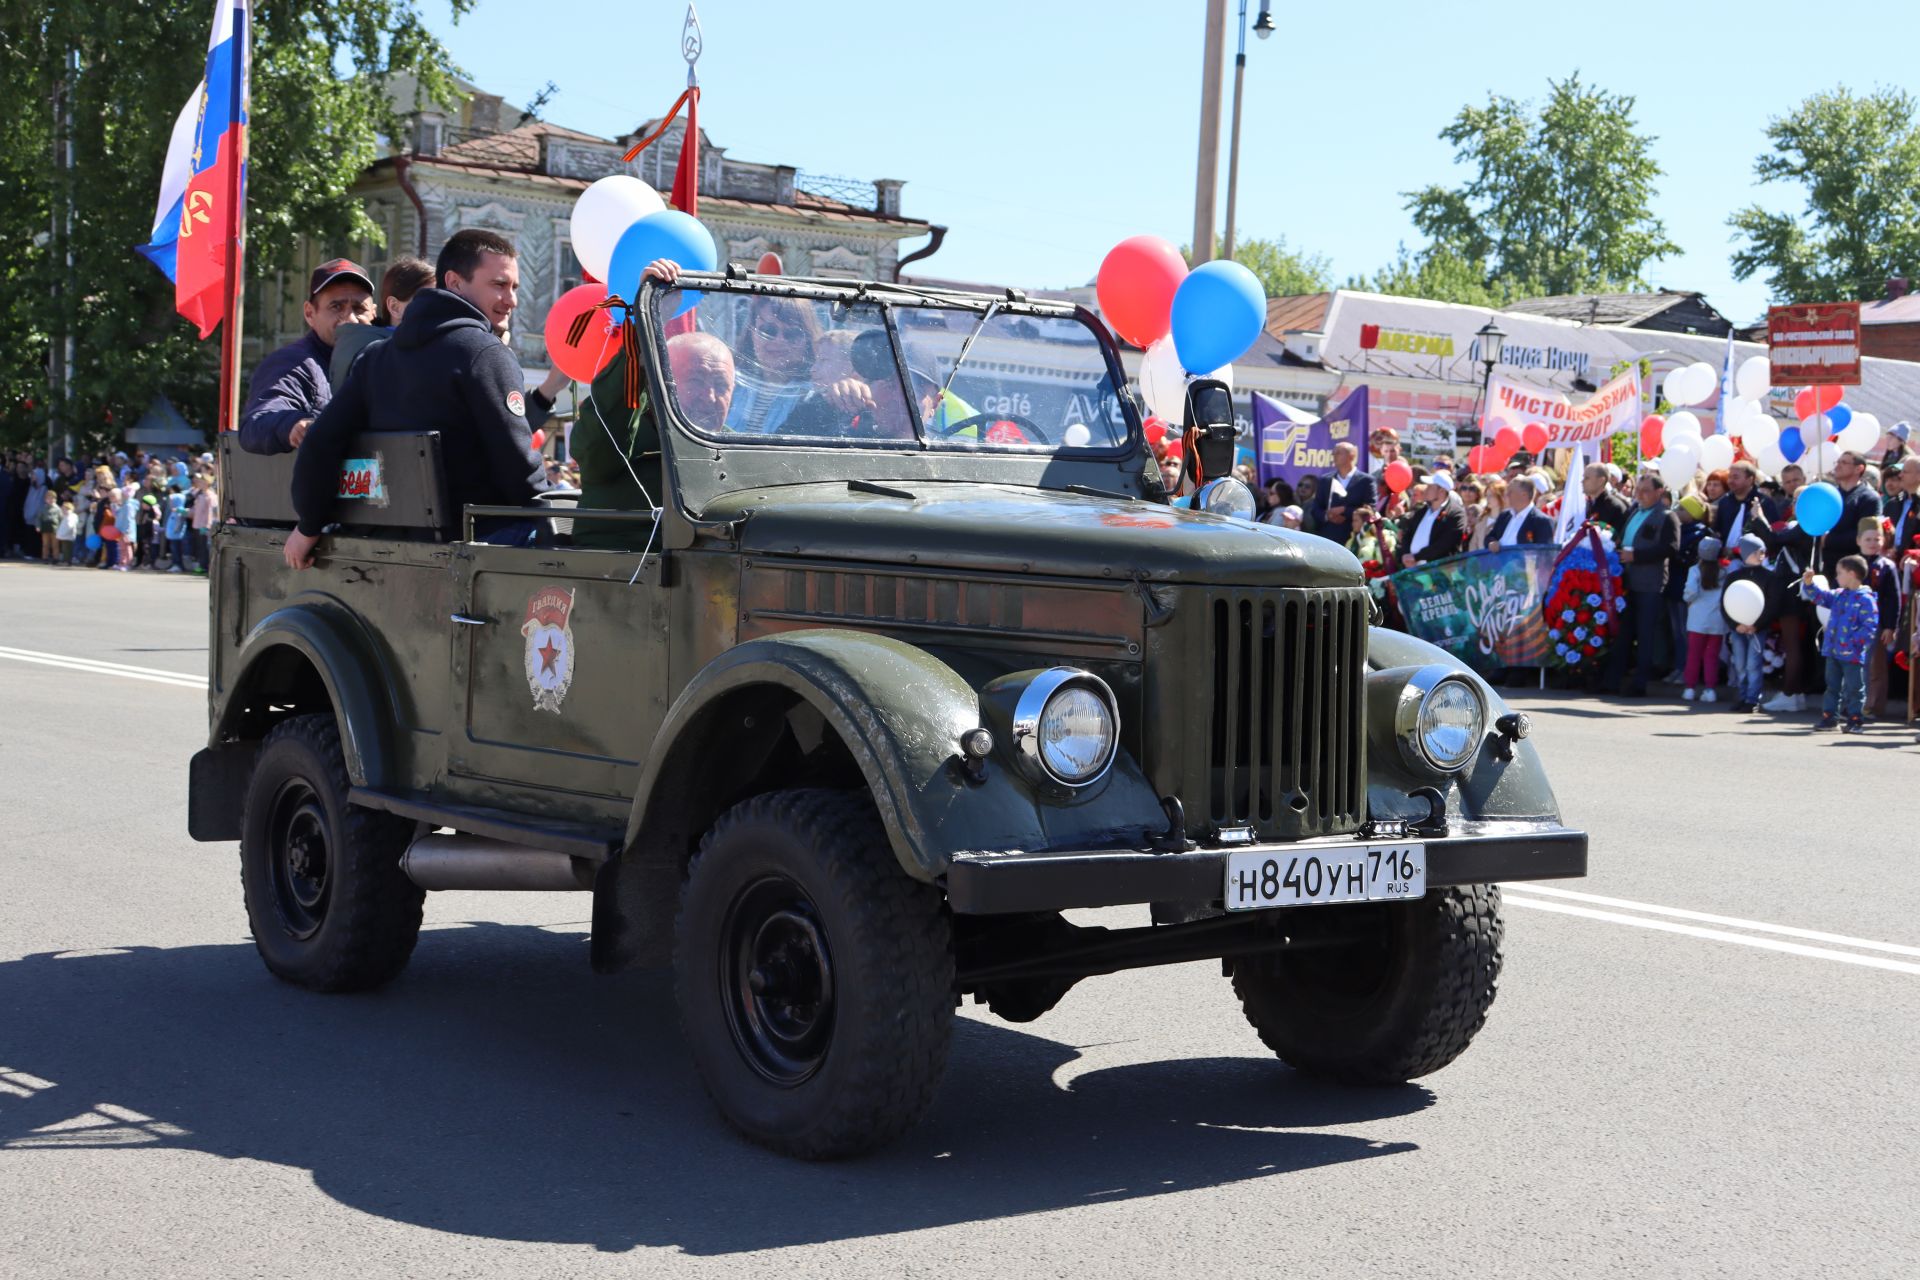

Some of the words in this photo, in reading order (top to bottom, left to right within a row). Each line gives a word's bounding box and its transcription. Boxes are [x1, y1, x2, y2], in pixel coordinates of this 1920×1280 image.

[1547, 346, 1591, 376] Ночи
[984, 393, 1031, 416] café
[1547, 414, 1612, 442] ВТОДОР
[338, 469, 371, 496] беда
[532, 594, 568, 616] ГВАРДИЯ
[1368, 849, 1414, 883] 716
[1387, 882, 1410, 894] RUS
